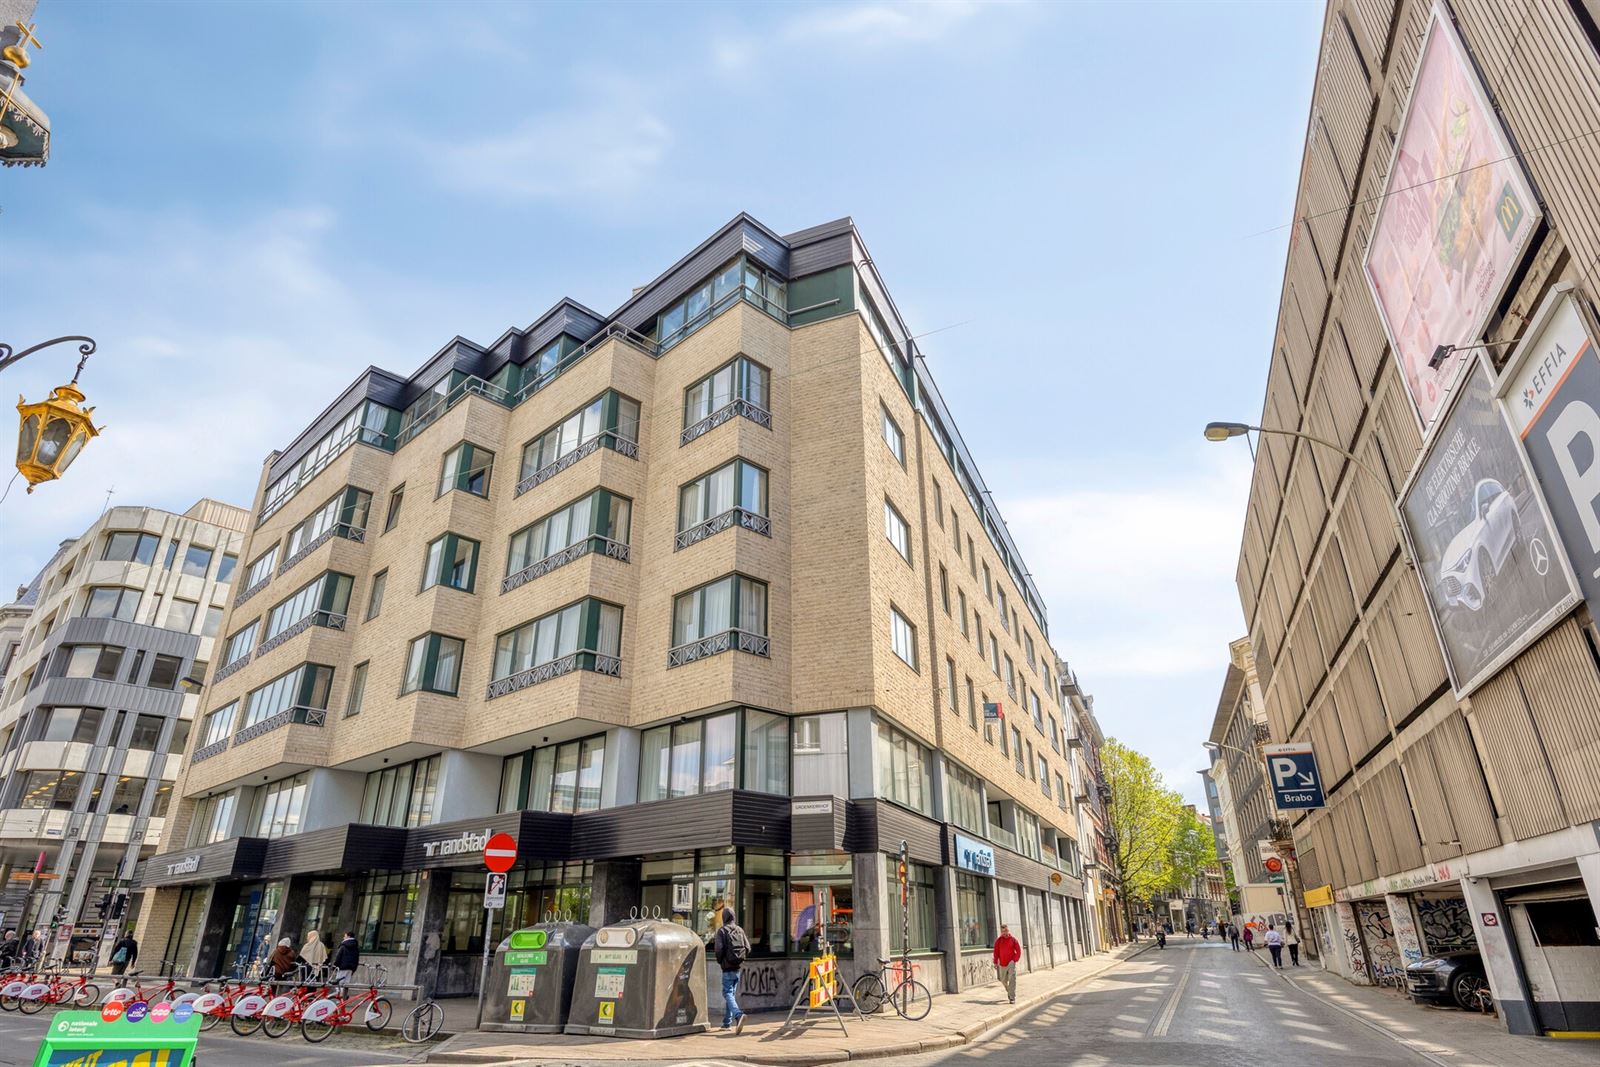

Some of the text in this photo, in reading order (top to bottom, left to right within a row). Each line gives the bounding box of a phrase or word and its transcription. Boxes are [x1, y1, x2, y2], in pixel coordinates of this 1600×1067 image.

[1532, 342, 1567, 396] EFFIA
[1425, 427, 1466, 502] DE ELEKTRISCHE
[1545, 400, 1600, 555] P
[1434, 466, 1460, 515] SHOOTING
[1271, 757, 1297, 787] P
[1284, 793, 1313, 803] Brabo
[440, 828, 492, 856] randstad
